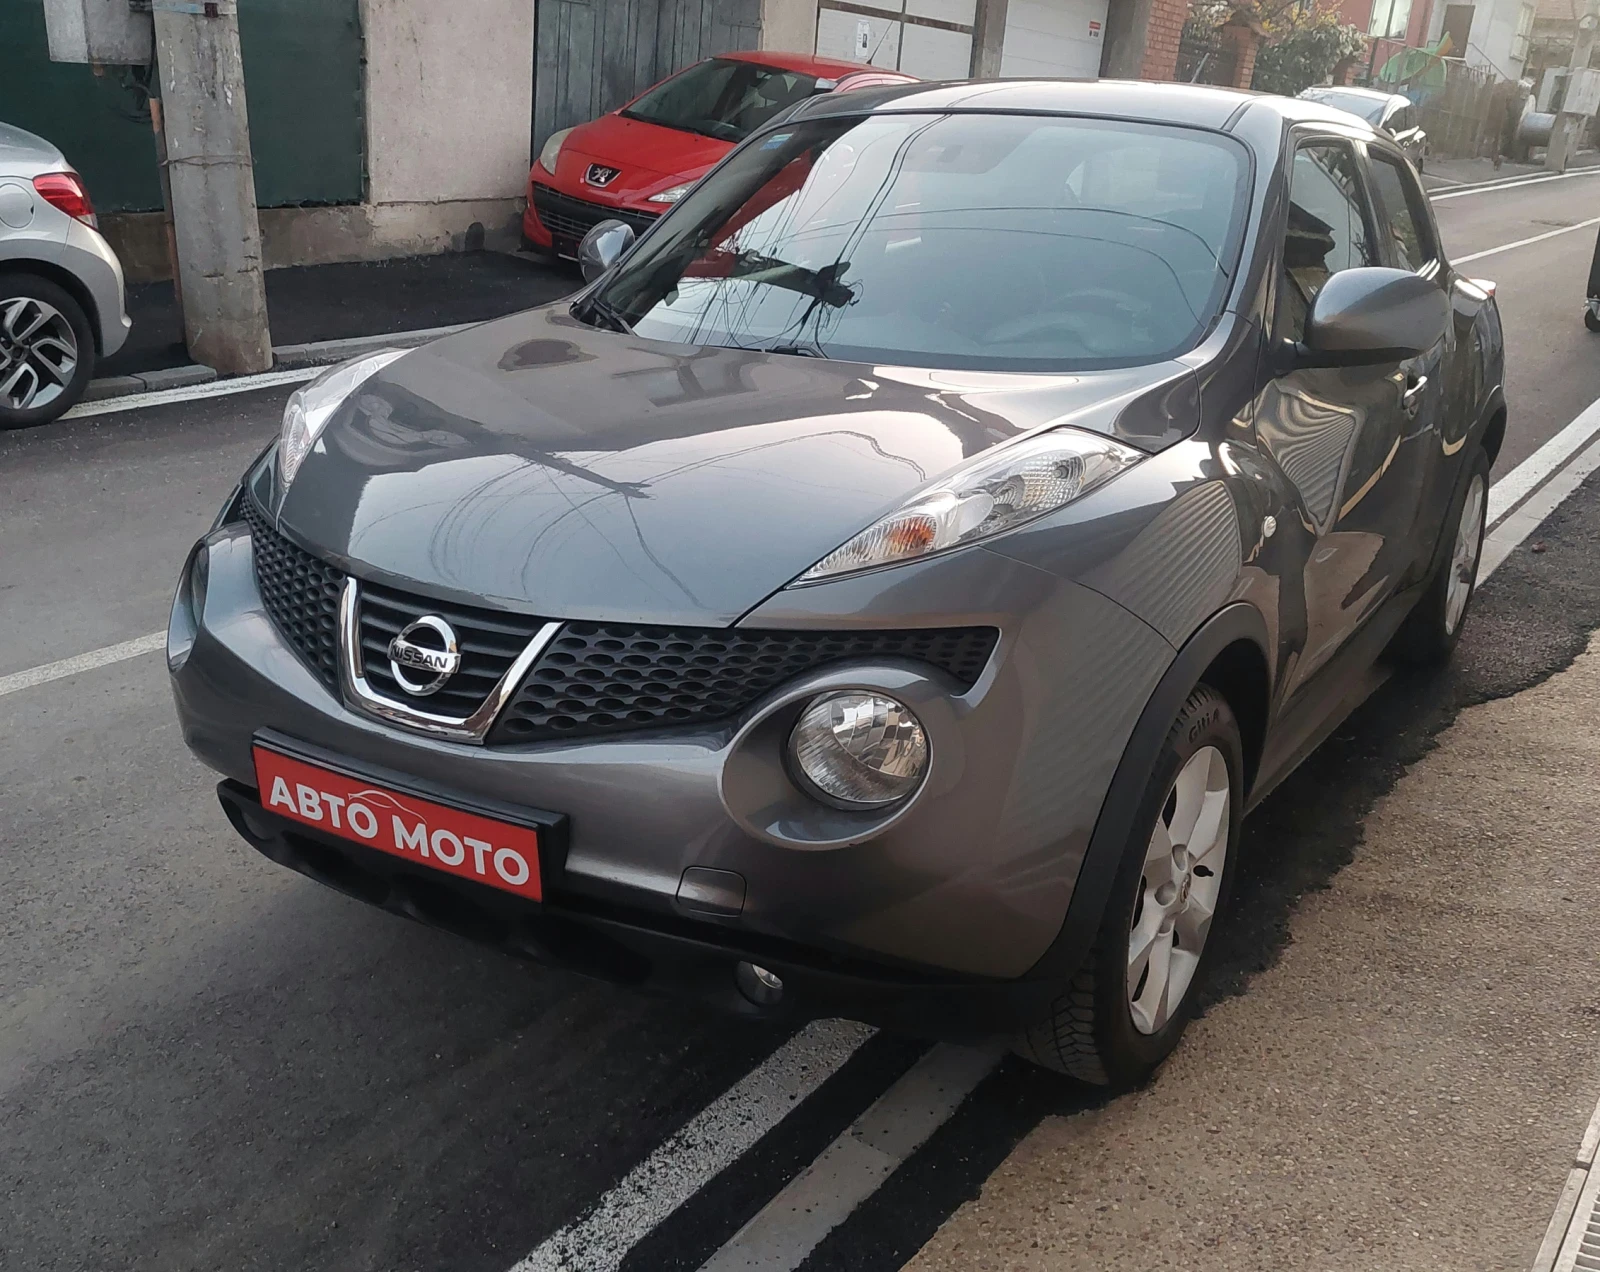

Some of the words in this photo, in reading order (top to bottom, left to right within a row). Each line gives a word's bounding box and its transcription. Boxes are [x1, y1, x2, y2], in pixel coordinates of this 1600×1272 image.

[390, 644, 448, 669] NISSAN
[269, 775, 378, 839] АВТО
[391, 814, 530, 886] МОТО
